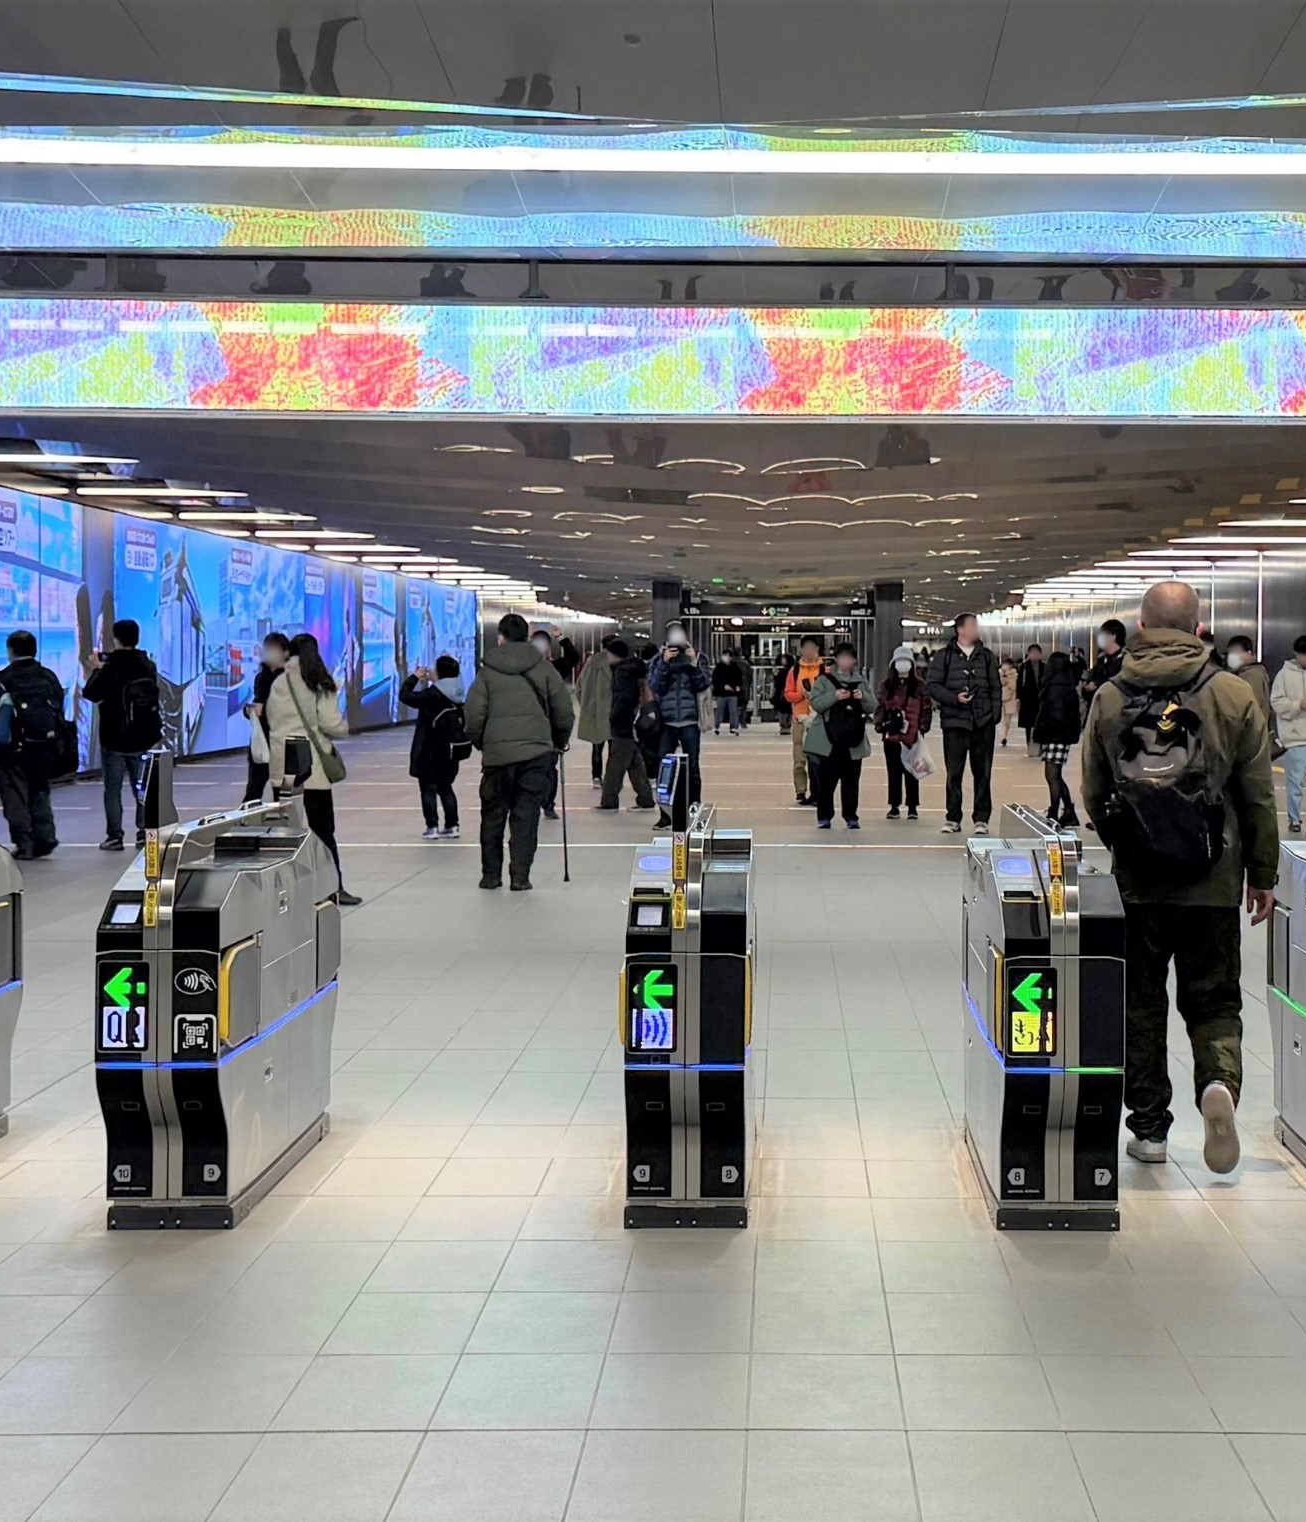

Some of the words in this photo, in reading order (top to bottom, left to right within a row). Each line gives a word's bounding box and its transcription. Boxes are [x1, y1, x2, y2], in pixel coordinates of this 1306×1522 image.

[1014, 1018, 1051, 1046] きっ
[118, 1168, 130, 1179] 10
[207, 1167, 215, 1178] 9
[638, 1168, 647, 1179] 9
[725, 1168, 733, 1180] 8
[1013, 1171, 1022, 1182] 8
[1098, 1171, 1106, 1182] 7
